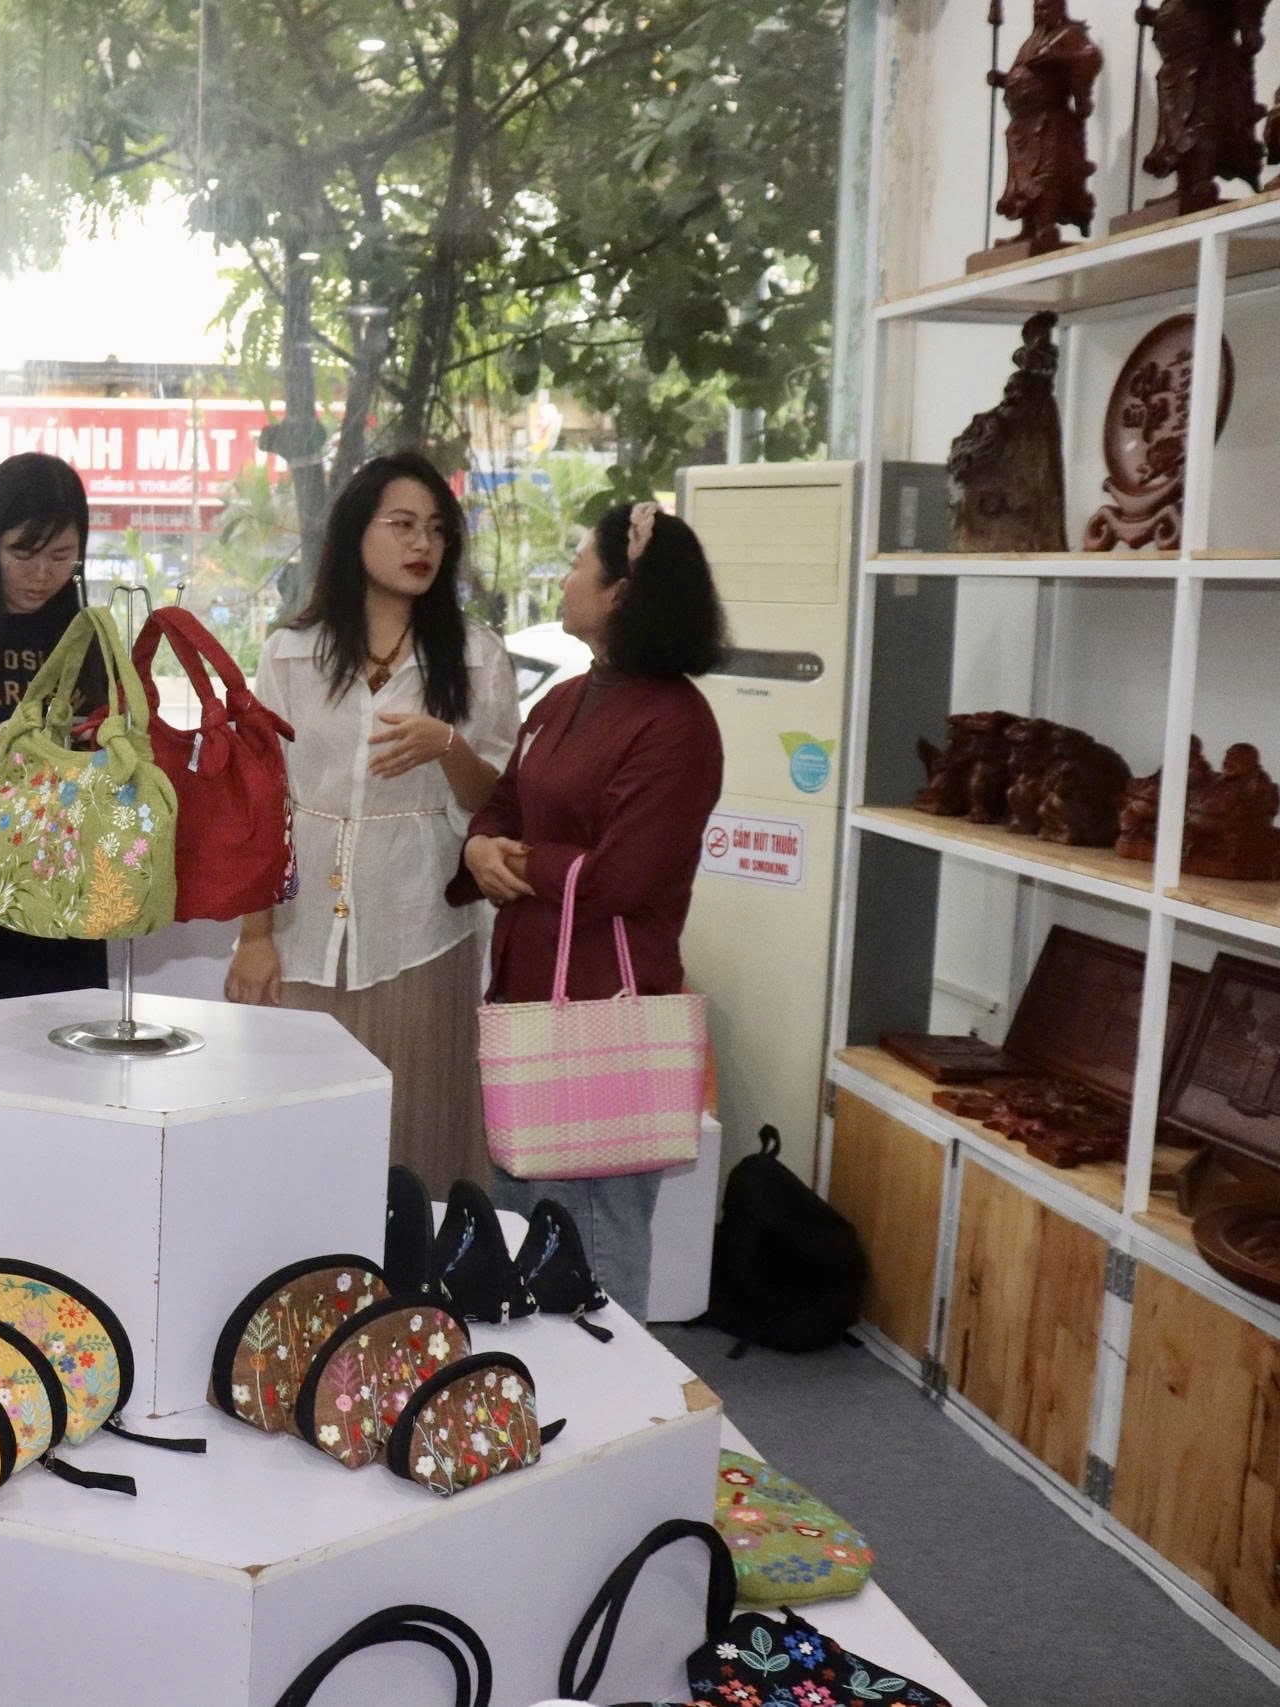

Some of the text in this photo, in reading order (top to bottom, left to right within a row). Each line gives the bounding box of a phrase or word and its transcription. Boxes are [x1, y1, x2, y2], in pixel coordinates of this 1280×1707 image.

[12, 417, 122, 470] KÍNH
[739, 858, 790, 876] NO SMOKING
